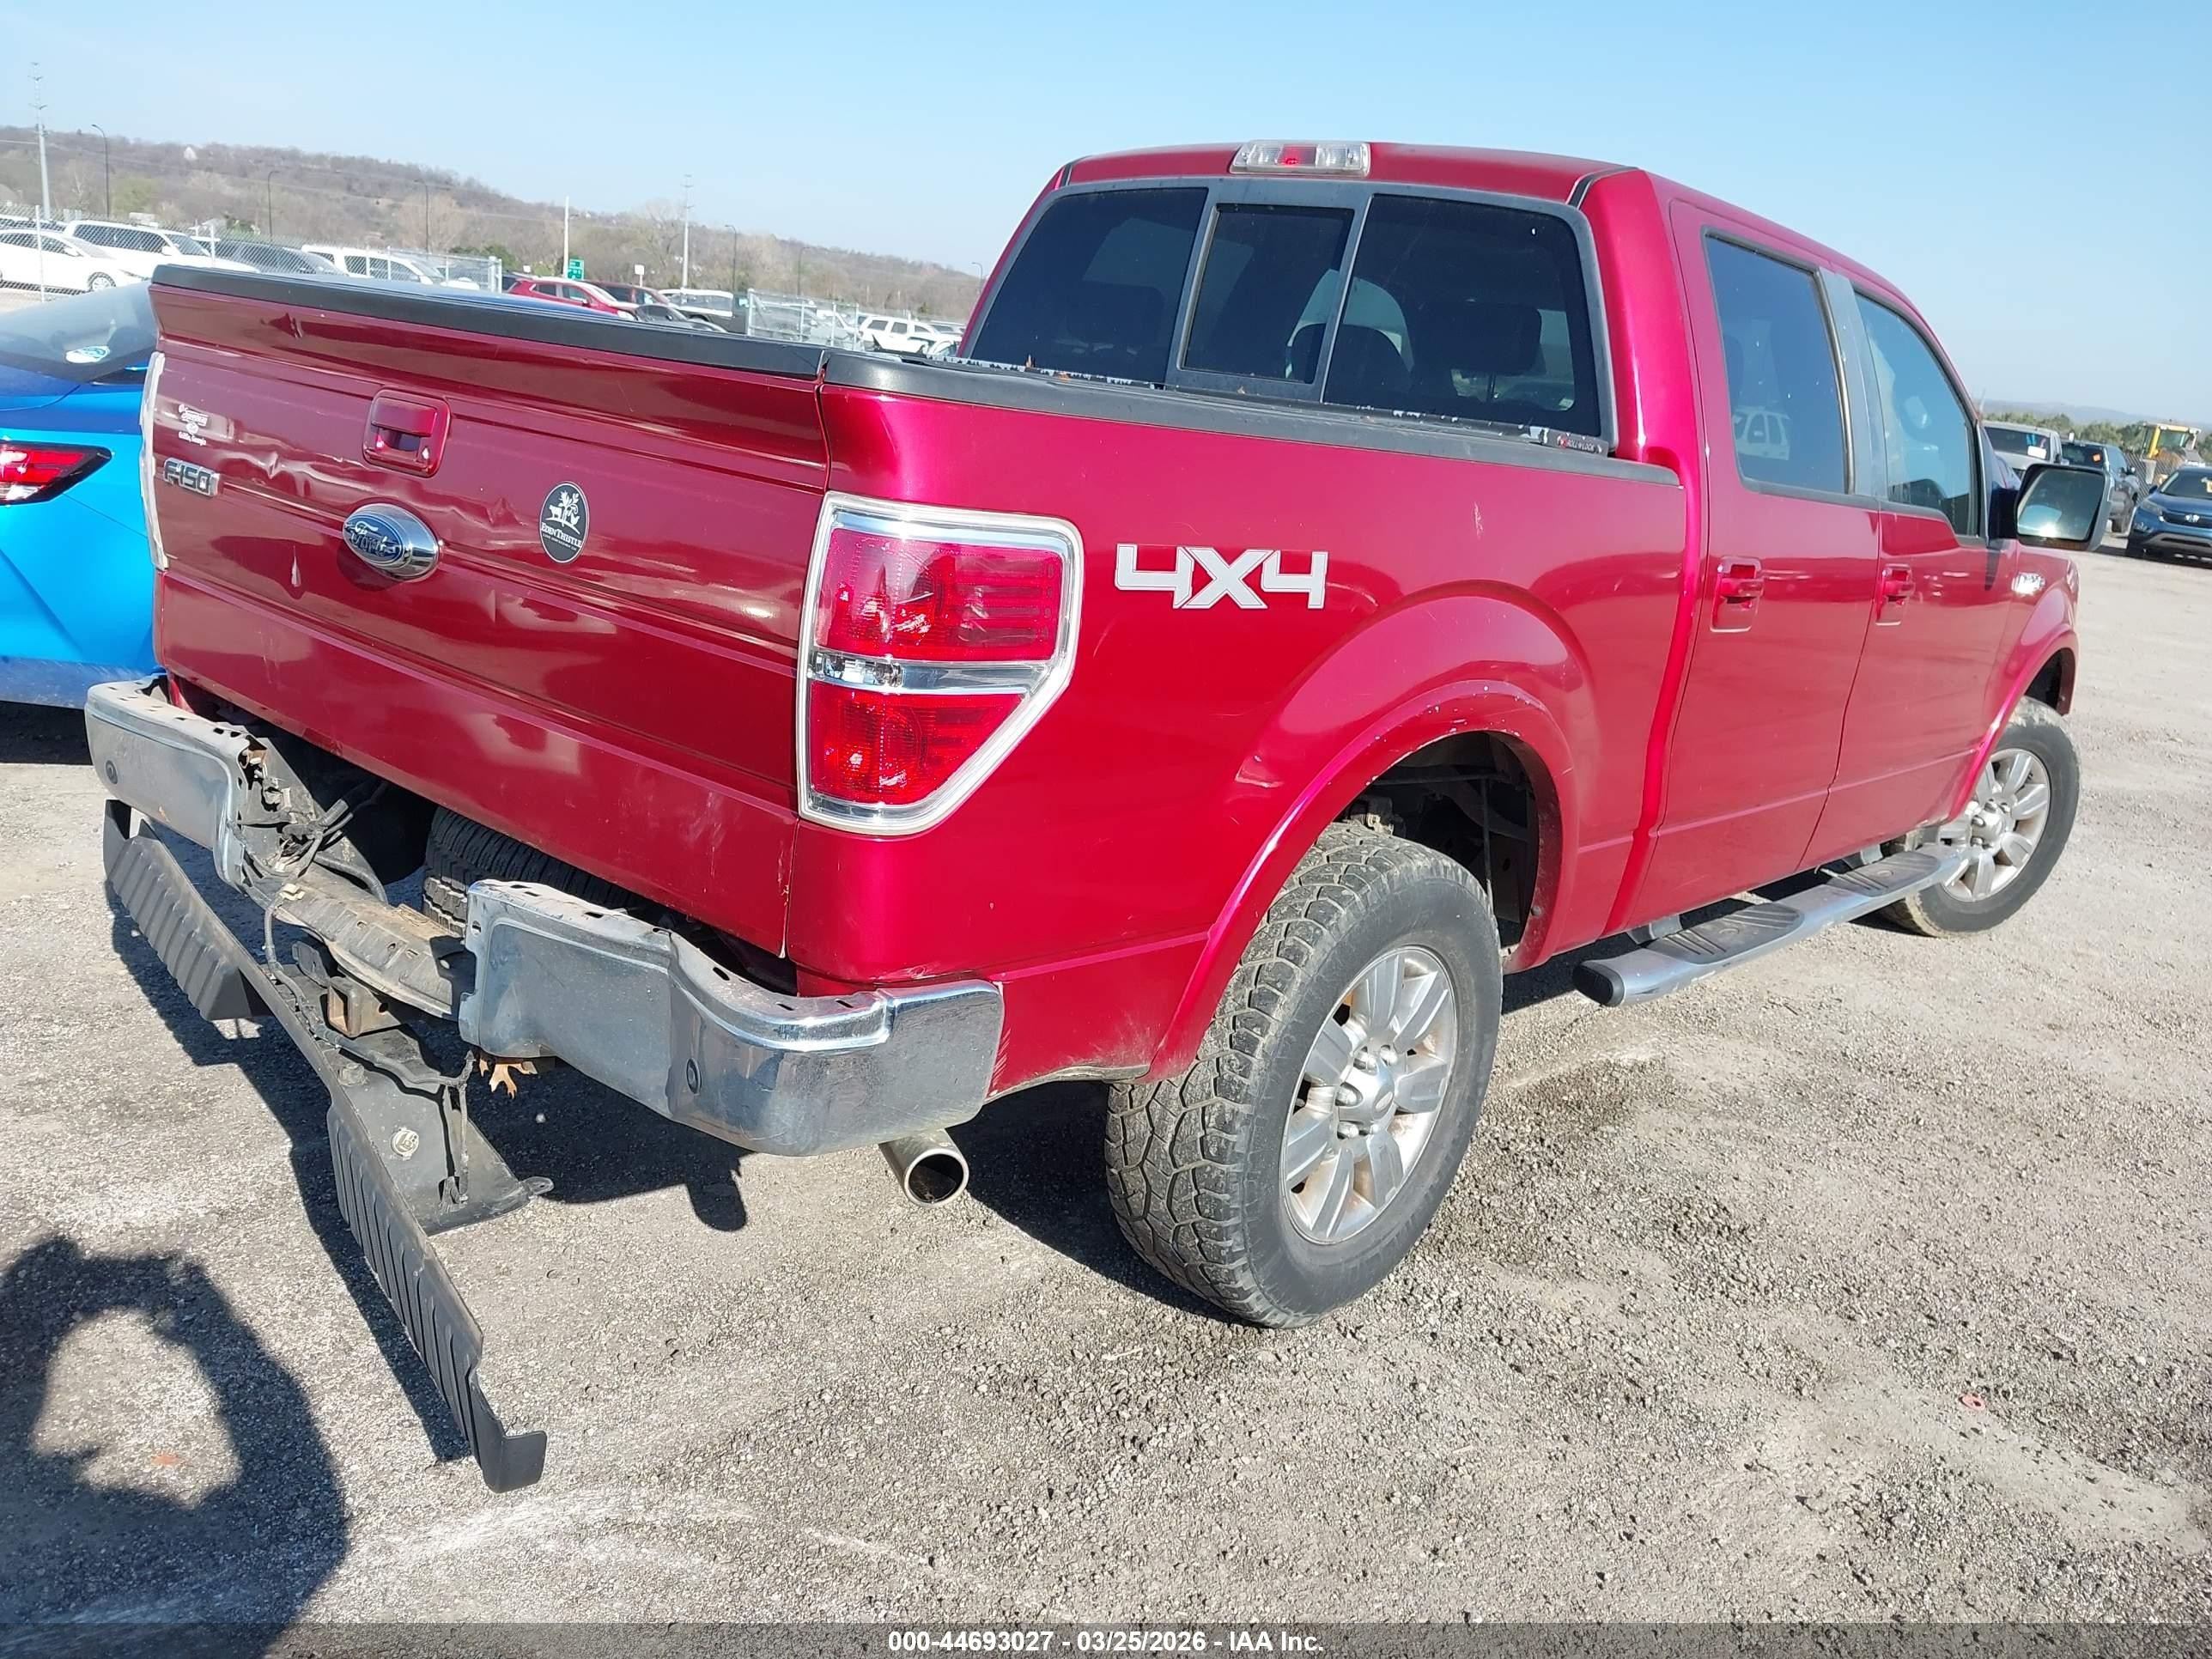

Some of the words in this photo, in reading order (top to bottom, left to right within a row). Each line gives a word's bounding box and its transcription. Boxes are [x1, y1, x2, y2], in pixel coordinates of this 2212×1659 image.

[165, 460, 211, 495] F-150
[344, 520, 402, 558] Ford
[1115, 543, 1328, 610] 4X4
